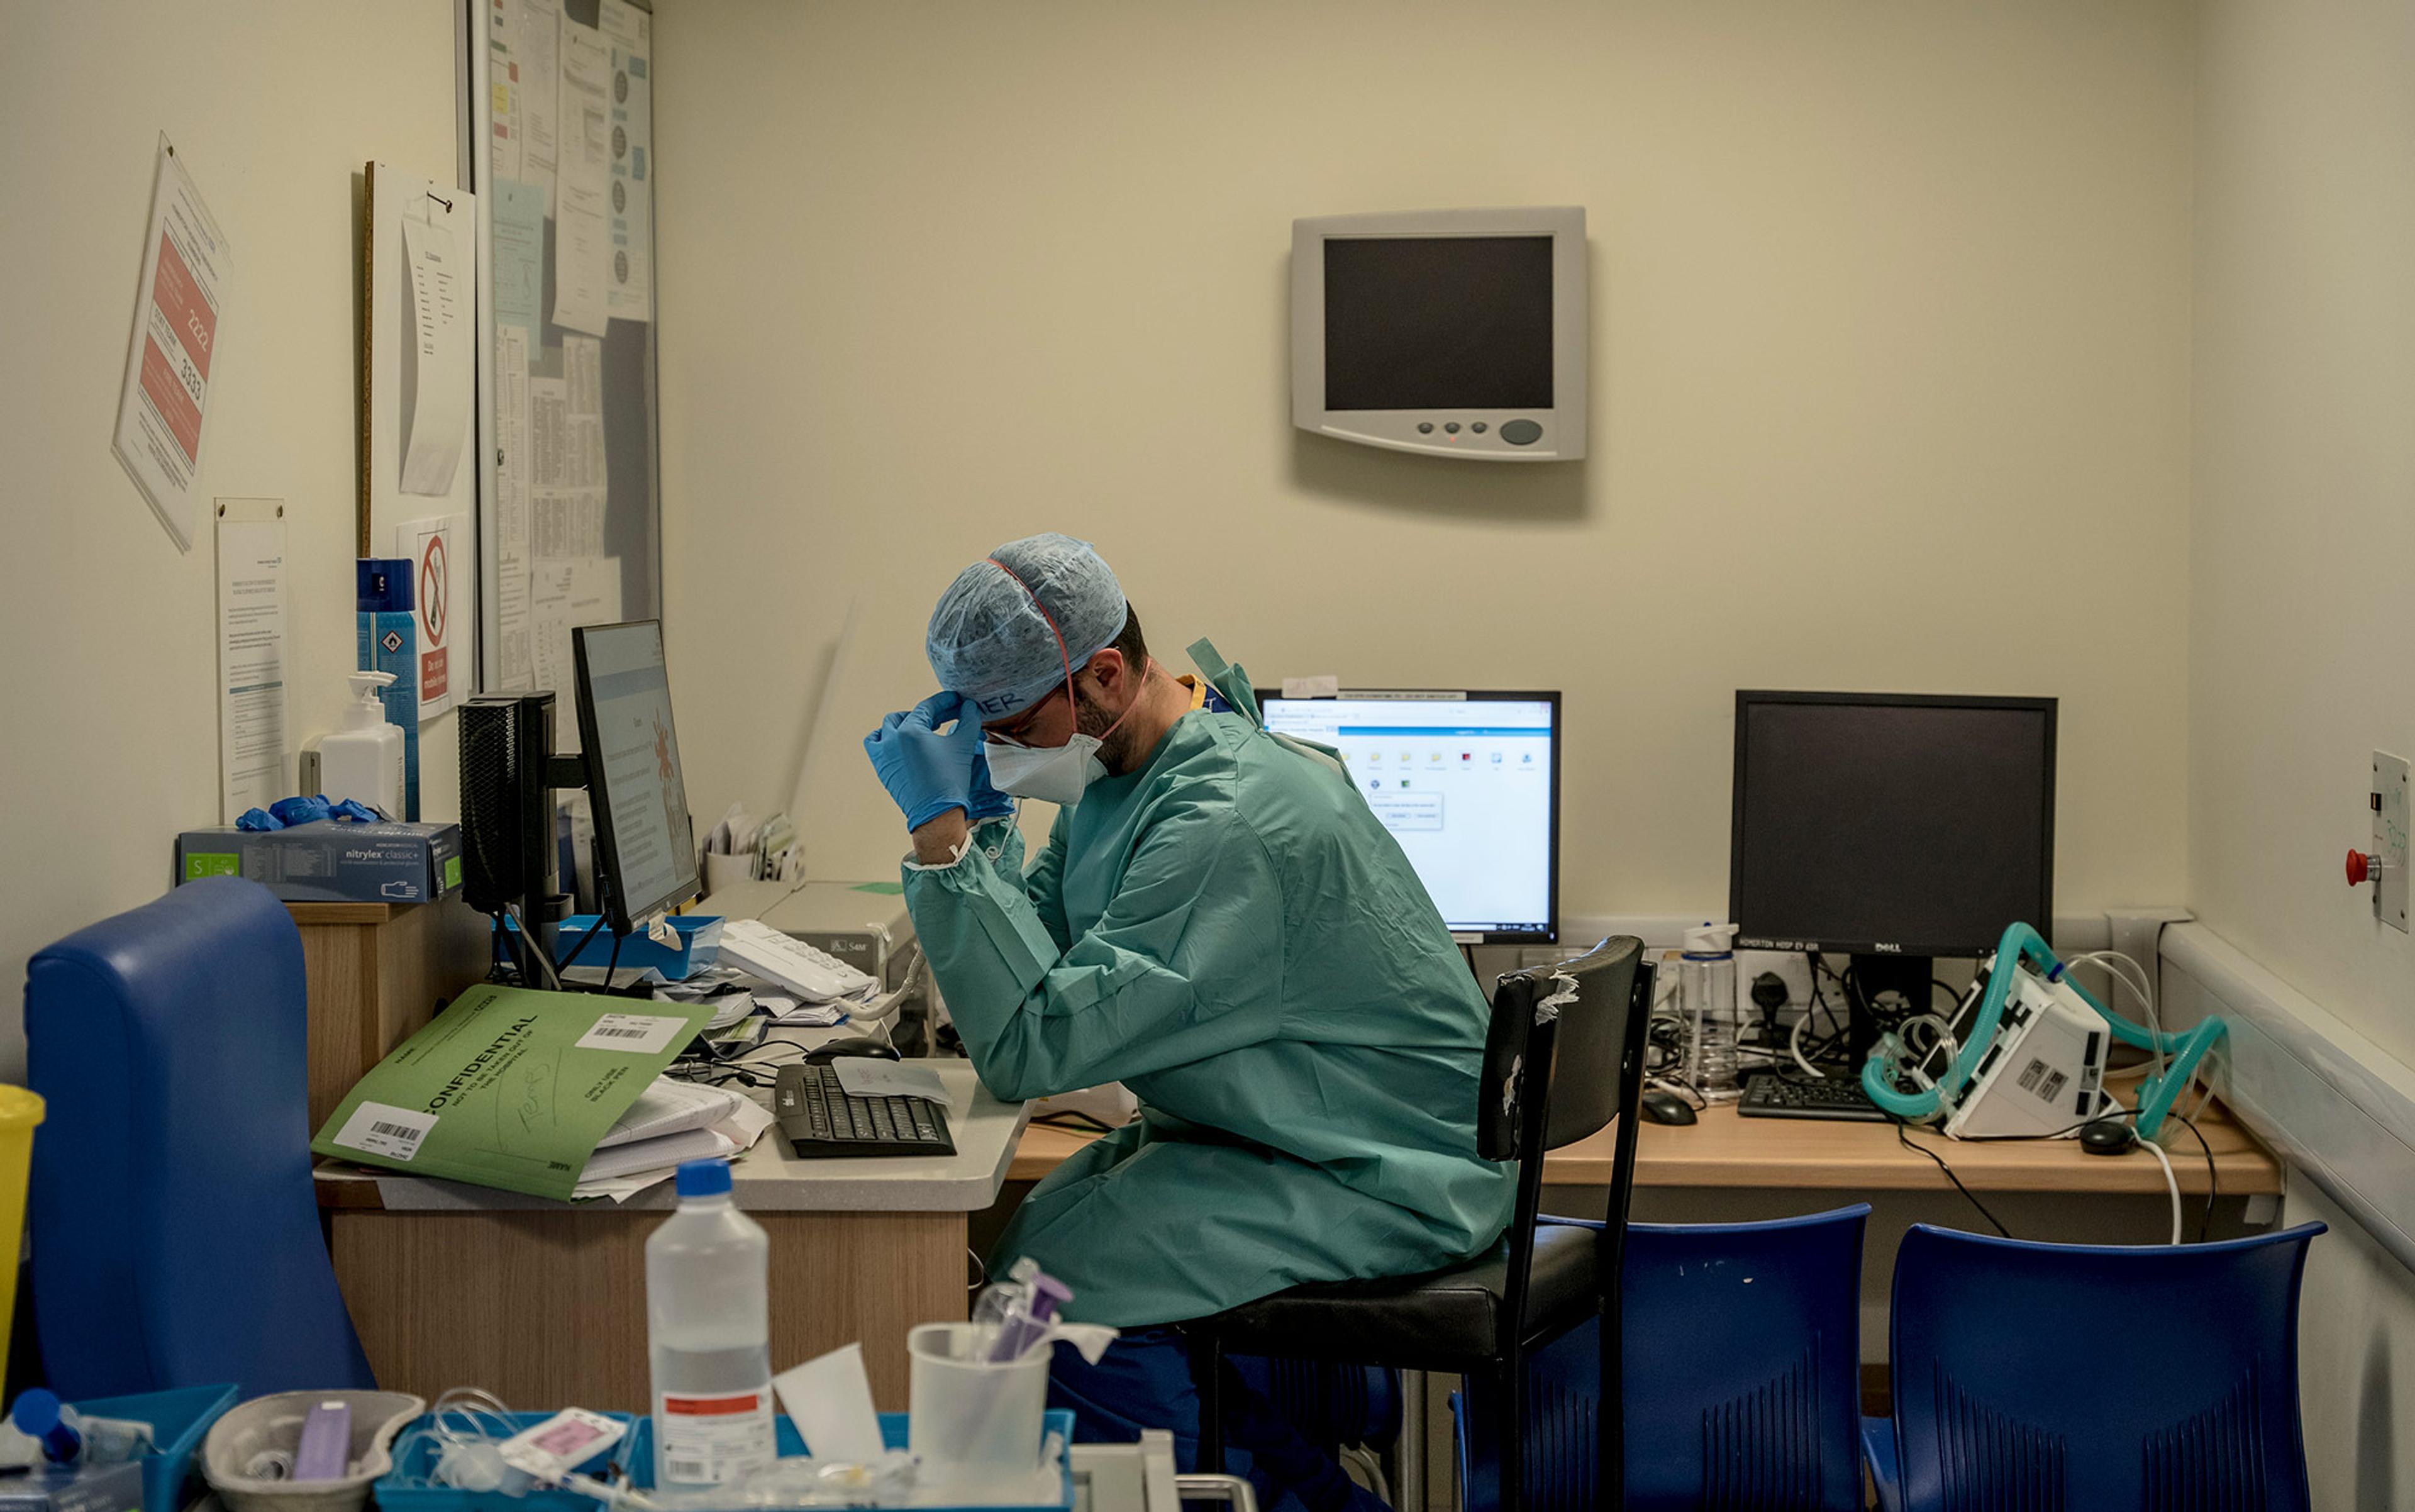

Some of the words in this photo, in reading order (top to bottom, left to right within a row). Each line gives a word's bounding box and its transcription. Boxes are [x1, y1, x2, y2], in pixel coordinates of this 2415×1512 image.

[188, 308, 209, 352] 2222
[181, 359, 201, 401] 3333
[193, 860, 203, 874] S
[1875, 943, 1902, 952] DELL
[452, 1092, 467, 1107] NOT
[466, 1082, 477, 1092] TO
[477, 1073, 487, 1082] BE
[486, 1052, 510, 1072] TAKEN
[509, 1039, 524, 1053] OUT
[480, 1077, 496, 1090] THE
